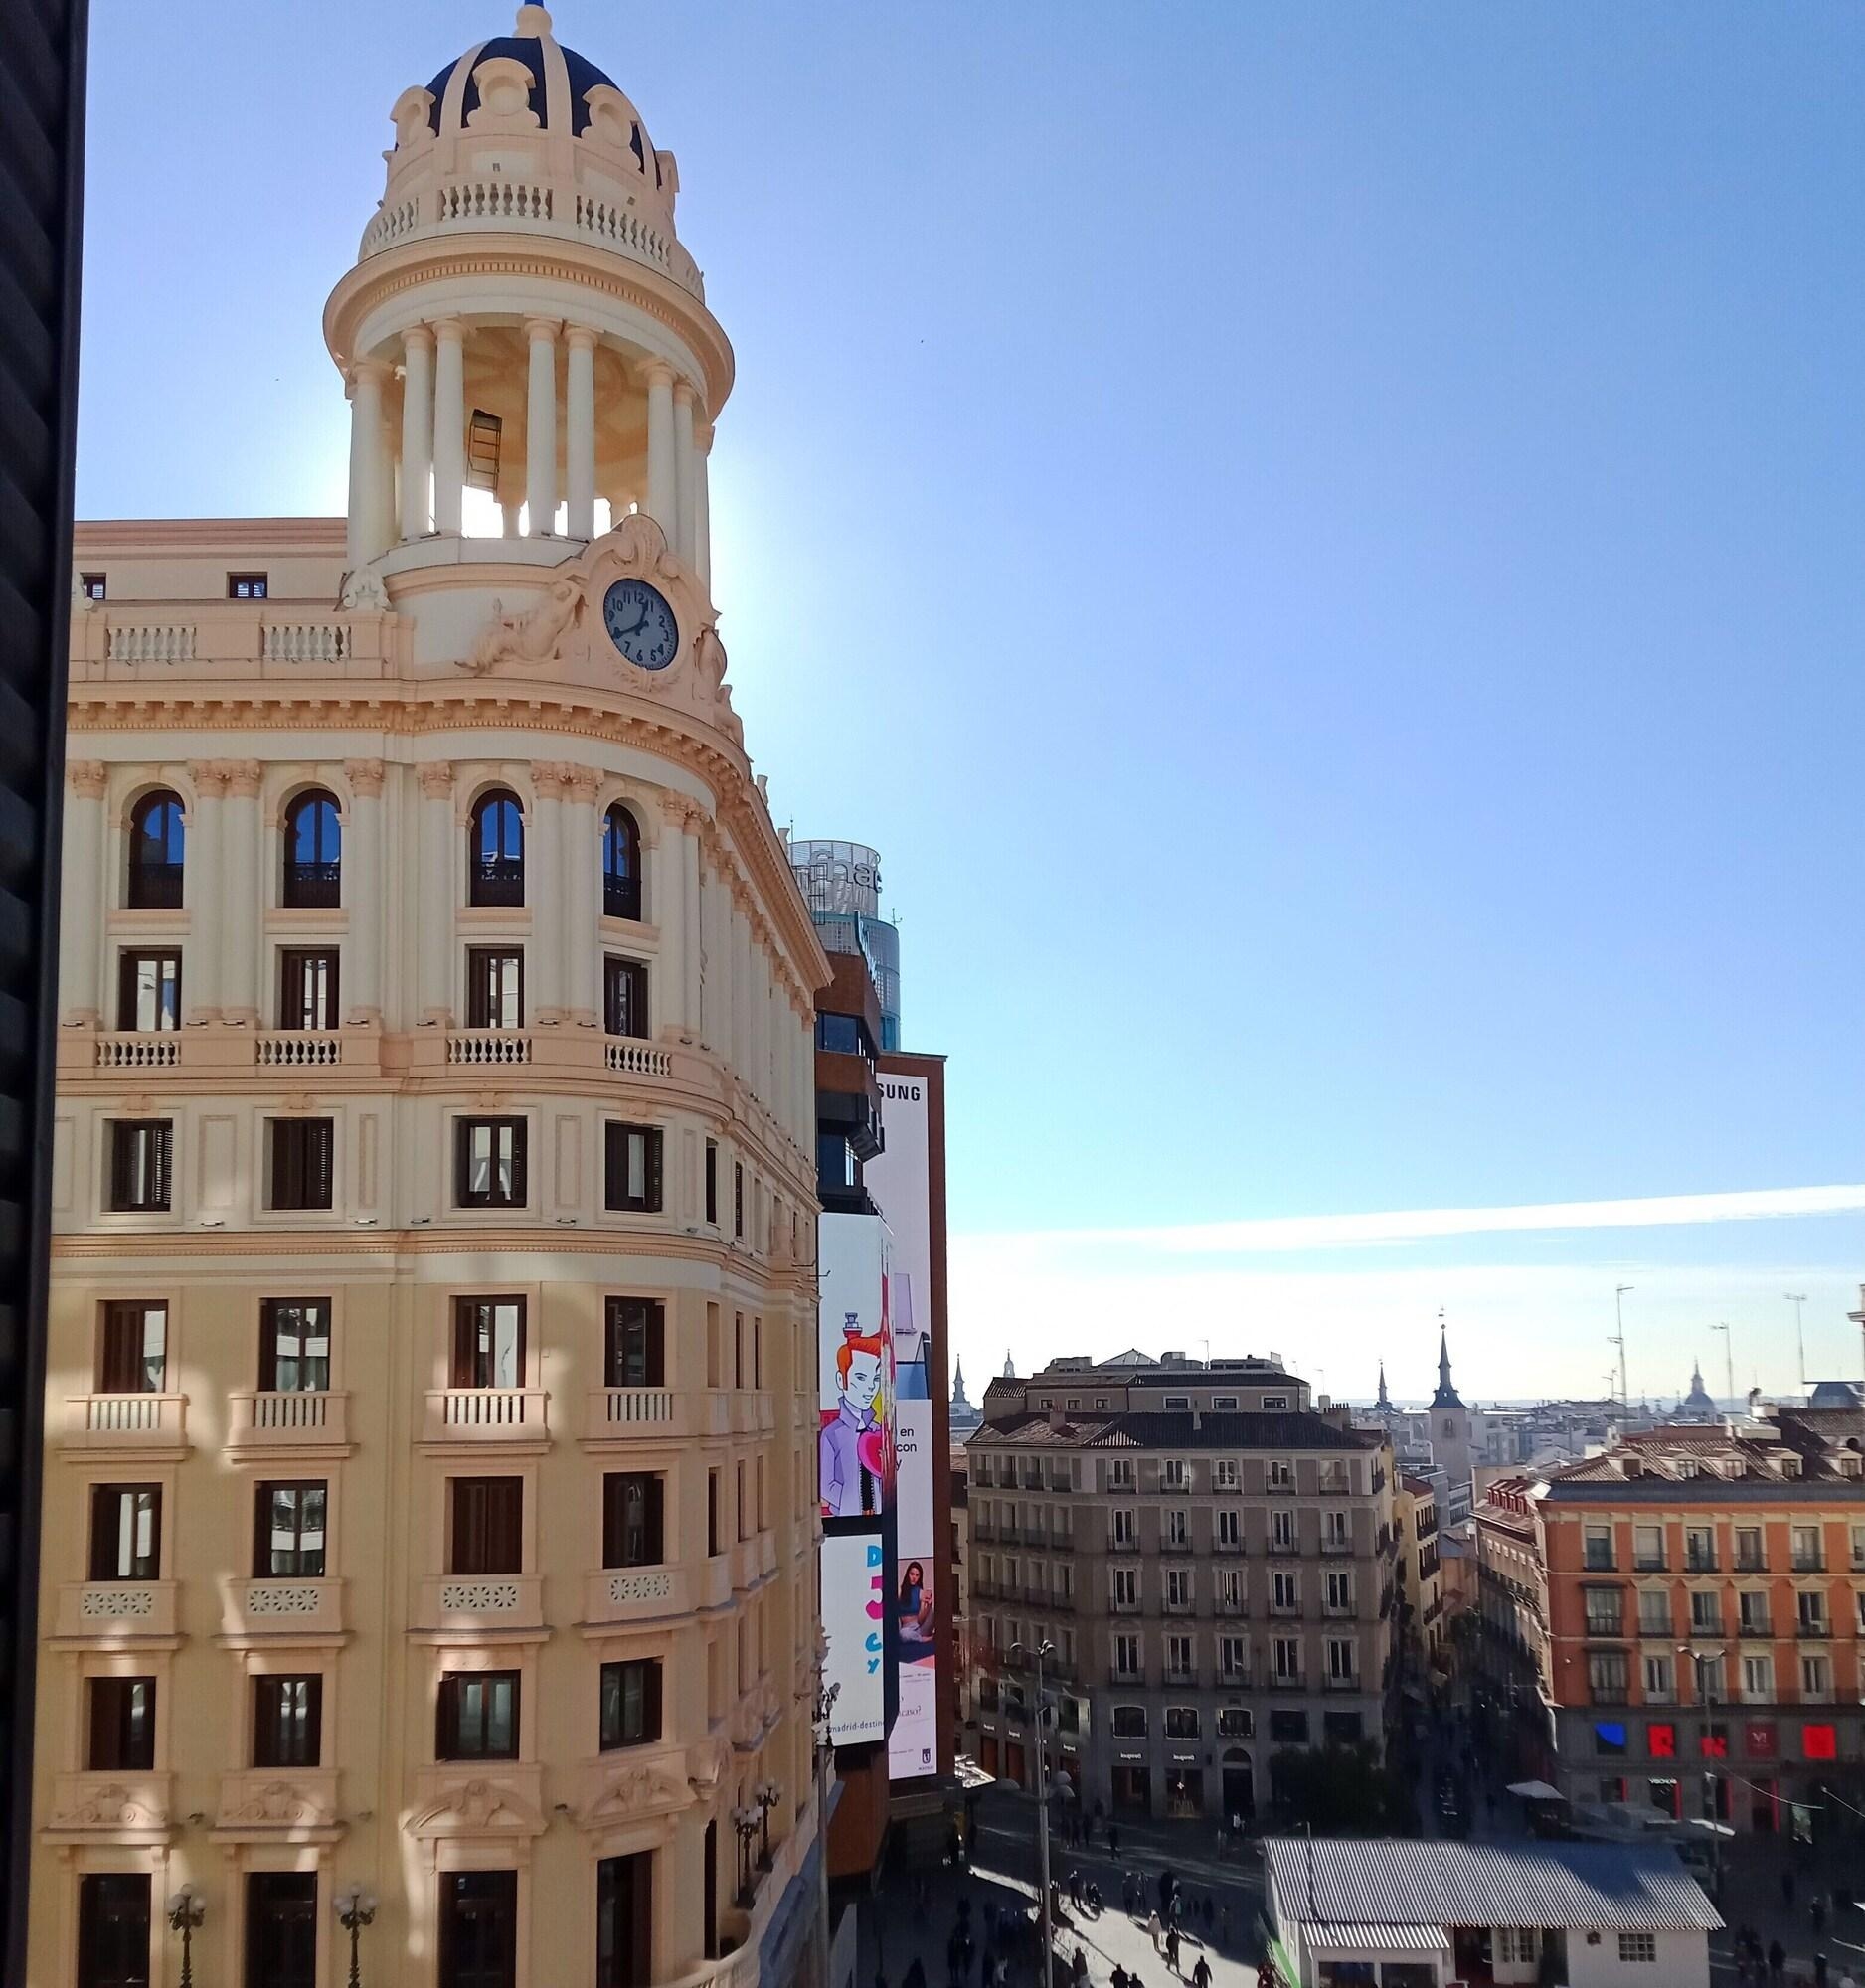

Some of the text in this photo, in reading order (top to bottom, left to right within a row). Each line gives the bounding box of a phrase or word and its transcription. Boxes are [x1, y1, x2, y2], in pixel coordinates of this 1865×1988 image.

[623, 590, 631, 605] 11
[634, 590, 644, 605] 12
[612, 598, 623, 612] 10
[608, 610, 615, 622] 9
[658, 615, 665, 628] 2
[663, 630, 669, 642] 3
[624, 641, 631, 653] 7
[657, 643, 664, 656] 4
[636, 649, 643, 662] 6
[650, 649, 657, 662] 5
[900, 1428, 914, 1437] en
[896, 1443, 917, 1452] con
[830, 1721, 885, 1733] madrid-destin
